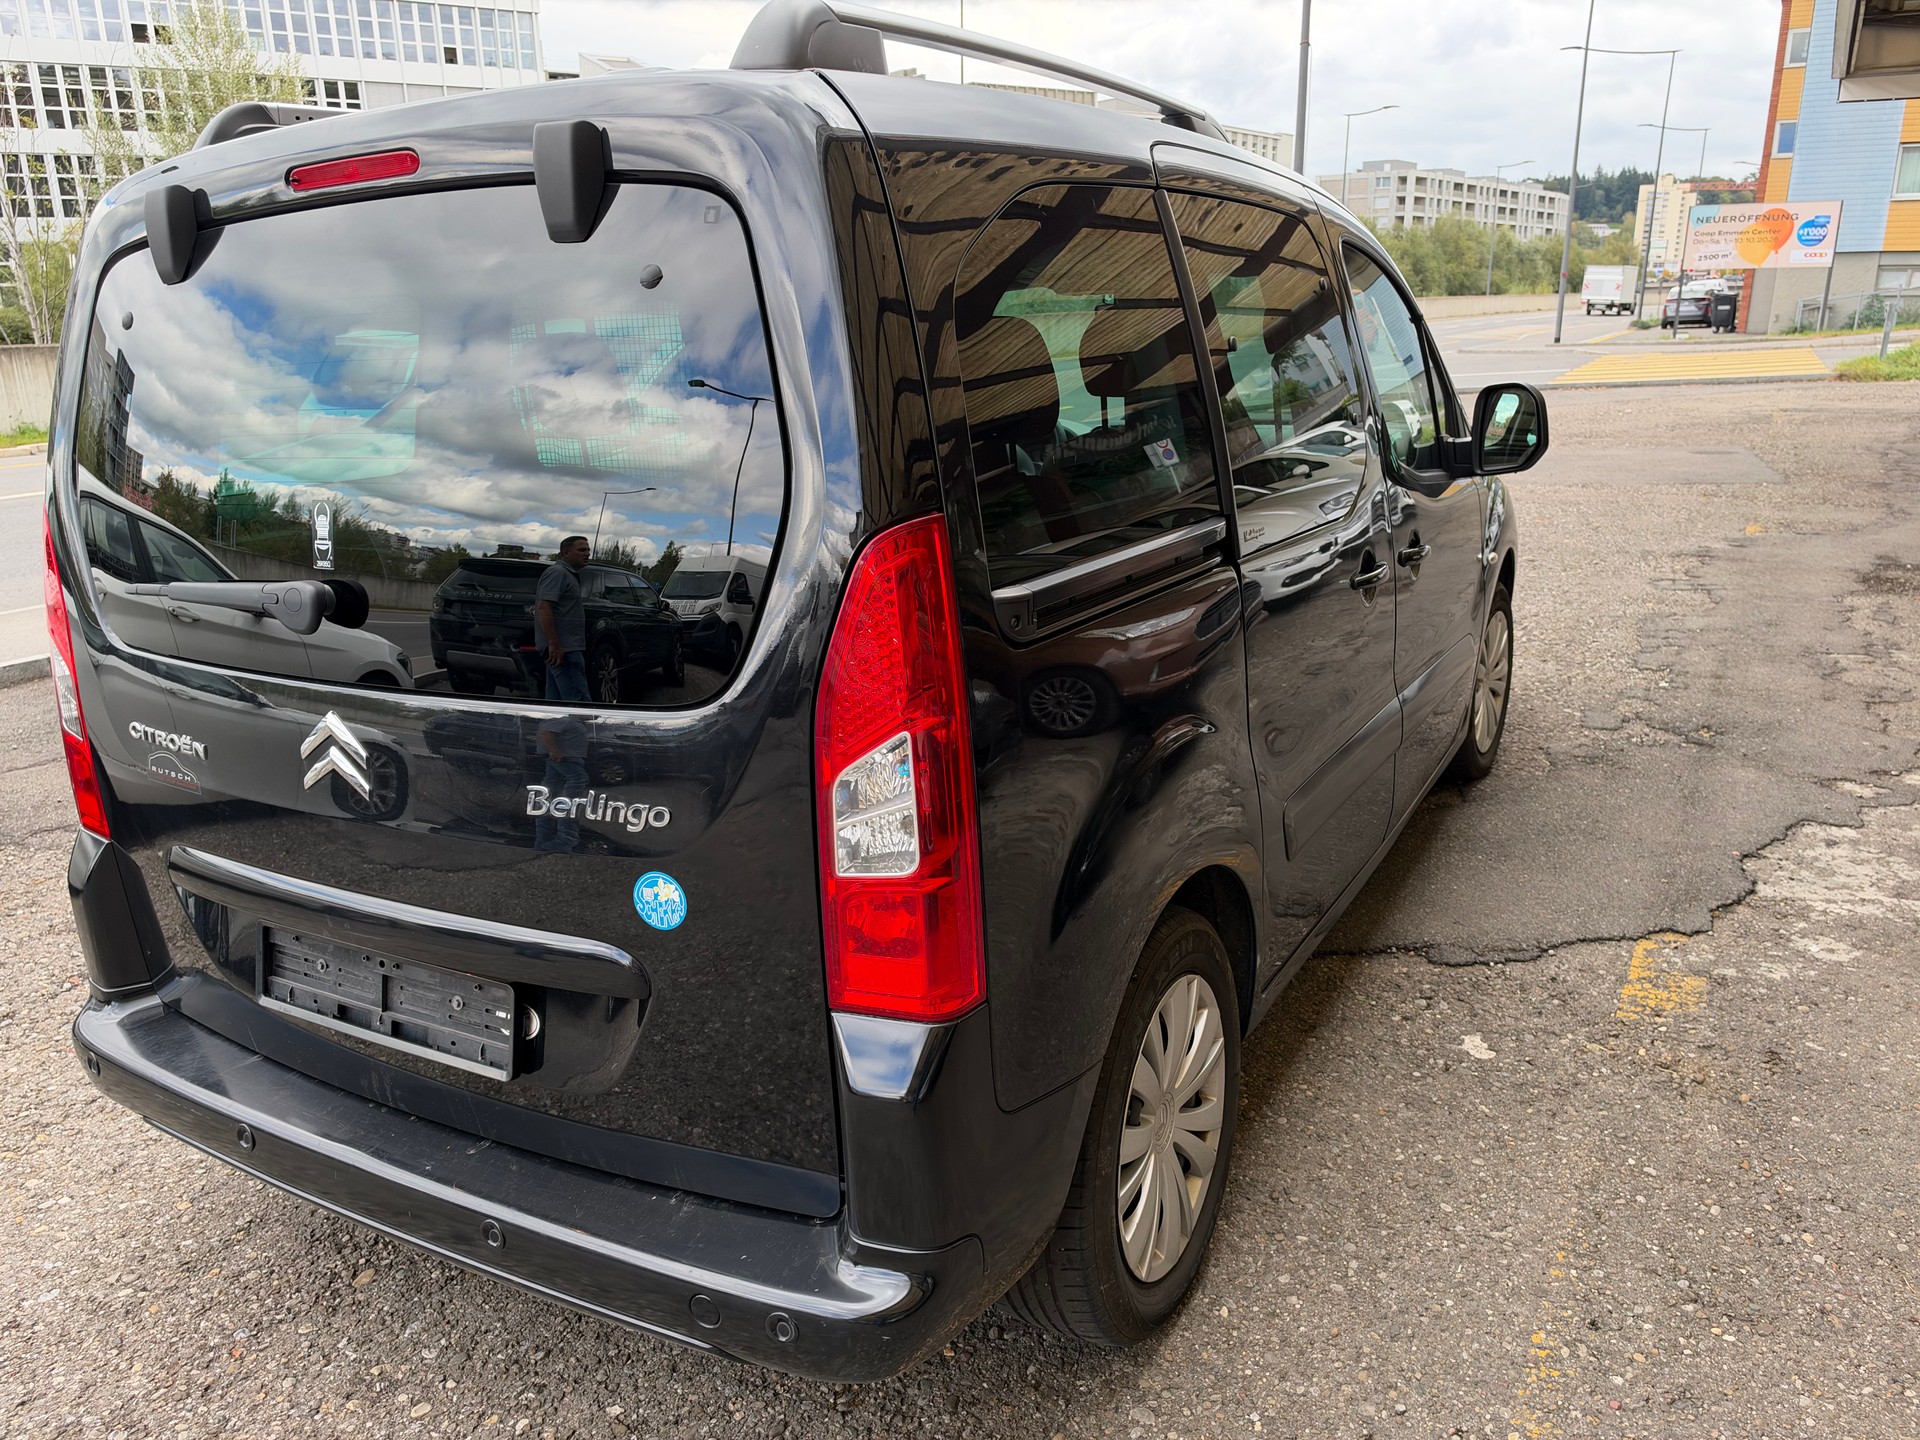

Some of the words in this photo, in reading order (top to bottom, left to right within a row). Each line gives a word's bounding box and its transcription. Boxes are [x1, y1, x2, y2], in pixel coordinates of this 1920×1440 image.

[1696, 212, 1799, 224] NEUERÖFFNUNG
[1694, 230, 1716, 238] Coop
[1717, 229, 1750, 237] Emmen
[129, 721, 209, 761] CITROËN
[151, 765, 191, 781] RUTSCH
[525, 784, 672, 833] Berlingo
